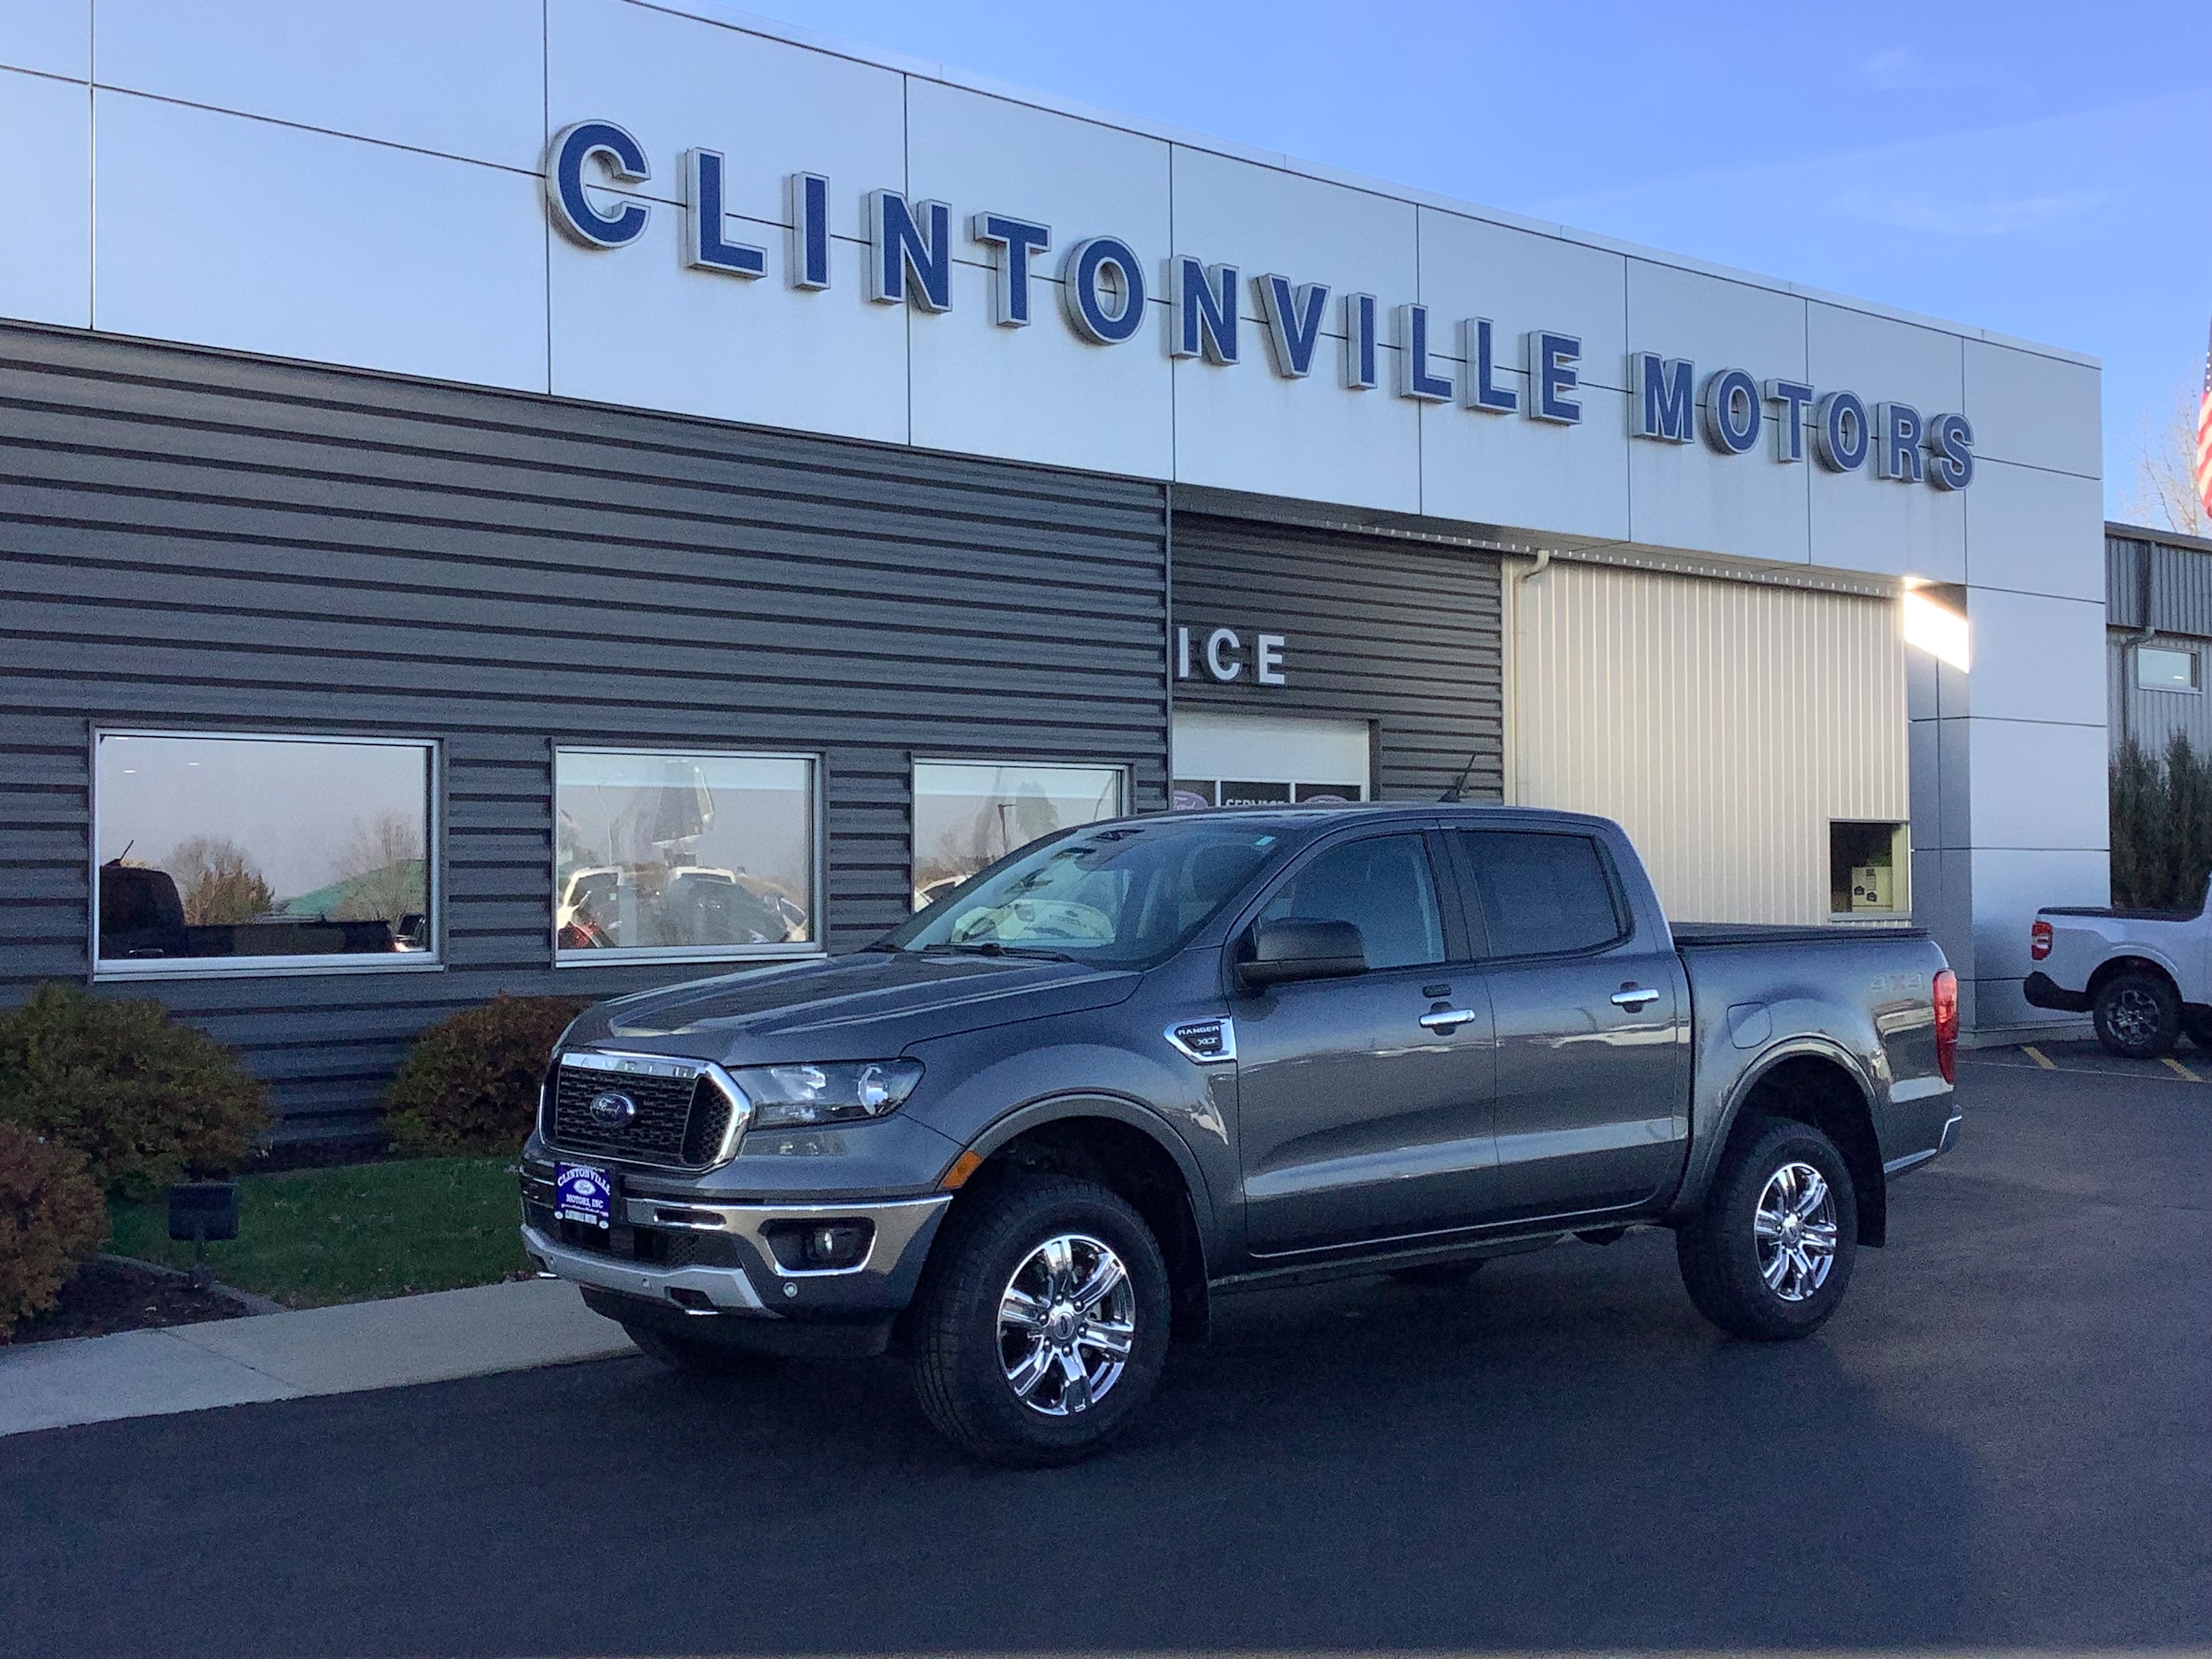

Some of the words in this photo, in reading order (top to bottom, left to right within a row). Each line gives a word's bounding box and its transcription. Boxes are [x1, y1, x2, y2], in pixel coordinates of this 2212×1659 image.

[547, 119, 1583, 426] CLINTONVILLE
[1632, 350, 1975, 491] MOTORS
[1178, 626, 1286, 686] ICE
[1178, 1025, 1220, 1036] RANGER
[1197, 1037, 1218, 1046] XLT
[557, 1167, 611, 1196] CLINTONVILLE
